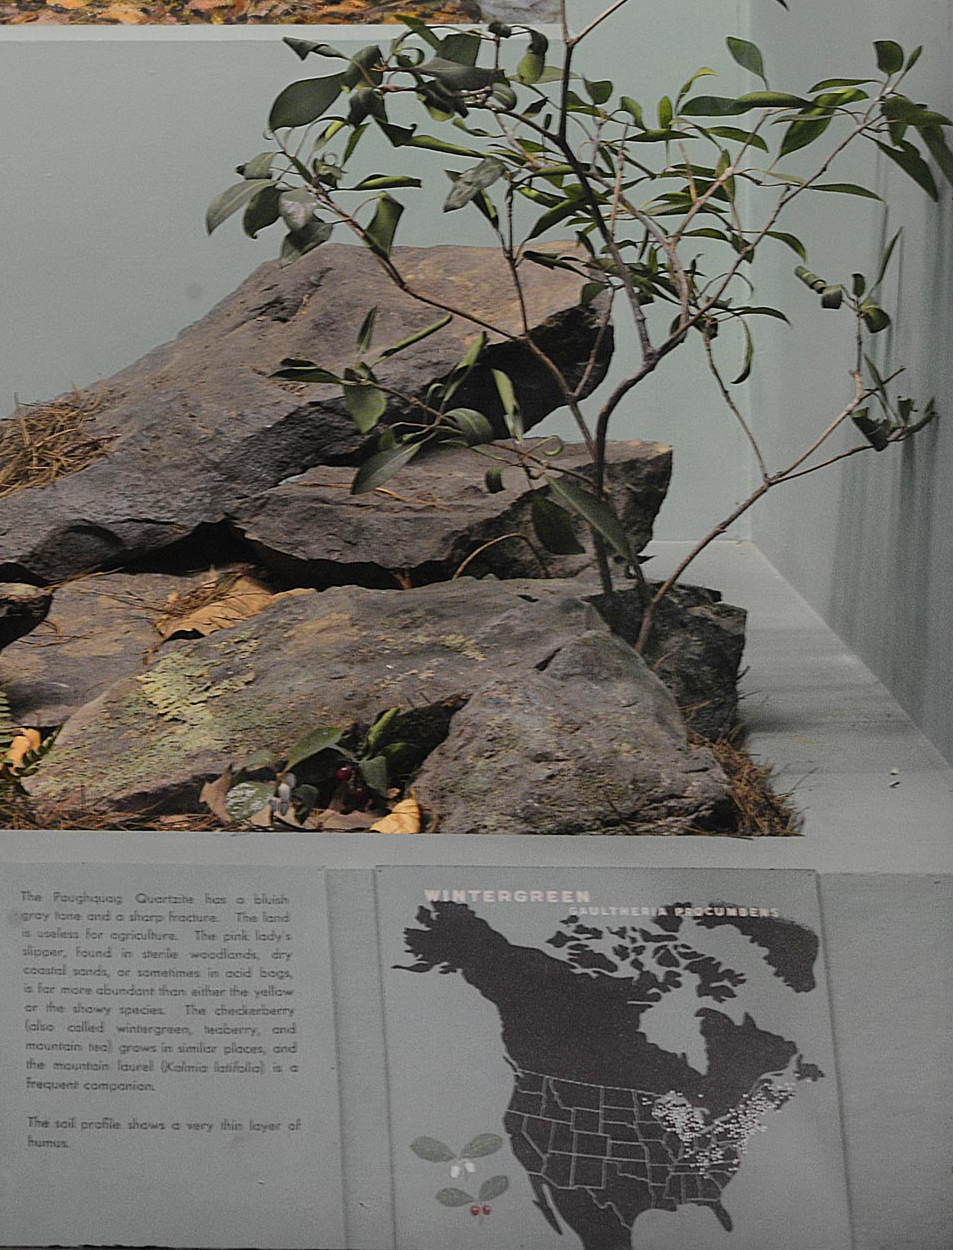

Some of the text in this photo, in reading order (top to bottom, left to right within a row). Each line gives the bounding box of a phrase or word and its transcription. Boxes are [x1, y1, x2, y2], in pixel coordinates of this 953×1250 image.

[19, 889, 290, 906] The Poughquag Quartzite has a bluish
[423, 888, 591, 904] WINTERGREEN
[20, 912, 50, 922] gray
[54, 911, 82, 921] tone
[86, 910, 111, 922] and
[115, 913, 125, 922] a
[129, 910, 164, 924] sharp
[235, 911, 258, 923] The
[262, 911, 291, 923] land
[567, 905, 780, 919] GAULTHERIA PROCUMBENS
[21, 930, 32, 938] is
[37, 927, 80, 940] useless
[85, 927, 104, 940] for
[194, 929, 217, 941] The
[223, 929, 249, 943] pink
[75, 946, 113, 959] found
[121, 951, 133, 959] in
[142, 947, 179, 960] sterile
[271, 951, 293, 962] dry
[22, 964, 67, 976] coastal
[116, 969, 131, 978] or
[137, 969, 201, 978] sometimes
[207, 970, 219, 978] in
[225, 967, 252, 979] acid
[23, 982, 295, 999] is far more abundant than either the yellow
[24, 1004, 39, 1013] or
[45, 1001, 65, 1014] the
[72, 1002, 111, 1016] showy
[184, 1003, 207, 1016] The
[214, 1004, 295, 1018] checkerberry
[66, 1020, 105, 1034] called
[271, 1022, 297, 1035] and
[25, 1042, 82, 1052] mountain
[118, 1044, 157, 1055] grows
[161, 1045, 173, 1053] in
[177, 1041, 218, 1054] similar
[272, 1041, 298, 1054] and
[25, 1057, 46, 1070] the
[53, 1062, 110, 1072] mountain
[117, 1059, 154, 1072] laurel
[272, 1064, 283, 1073] is
[289, 1064, 299, 1073] a
[25, 1076, 80, 1091] frequent
[26, 1115, 302, 1134] The soil profile shows a very thin layer of
